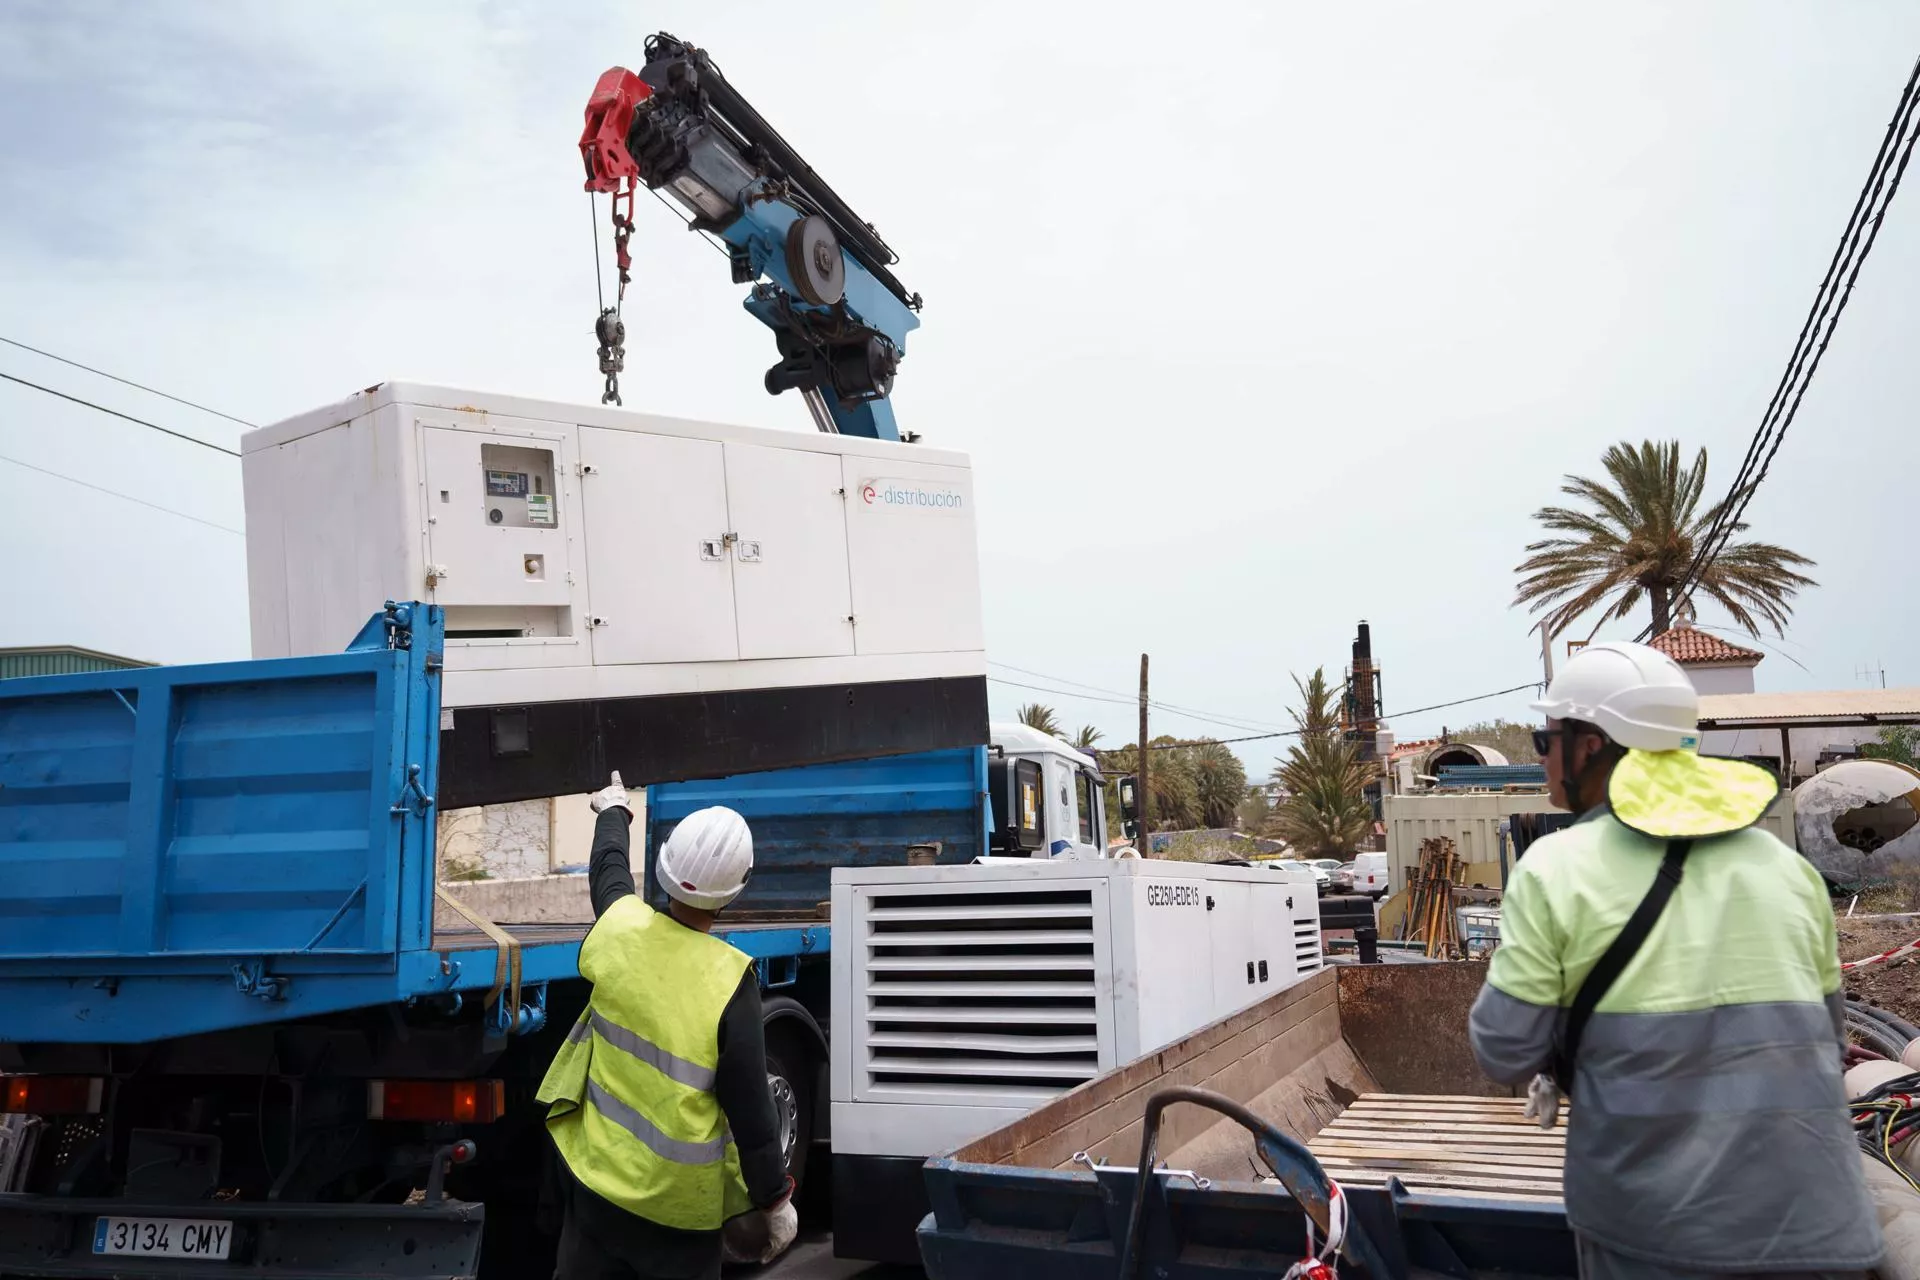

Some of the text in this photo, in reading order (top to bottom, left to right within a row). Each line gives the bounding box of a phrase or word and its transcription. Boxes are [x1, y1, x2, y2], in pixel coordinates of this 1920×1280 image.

[863, 485, 962, 508] e-distribución
[1147, 885, 1199, 906] GE250-EDE15
[114, 1222, 227, 1254] 3134 CMY
